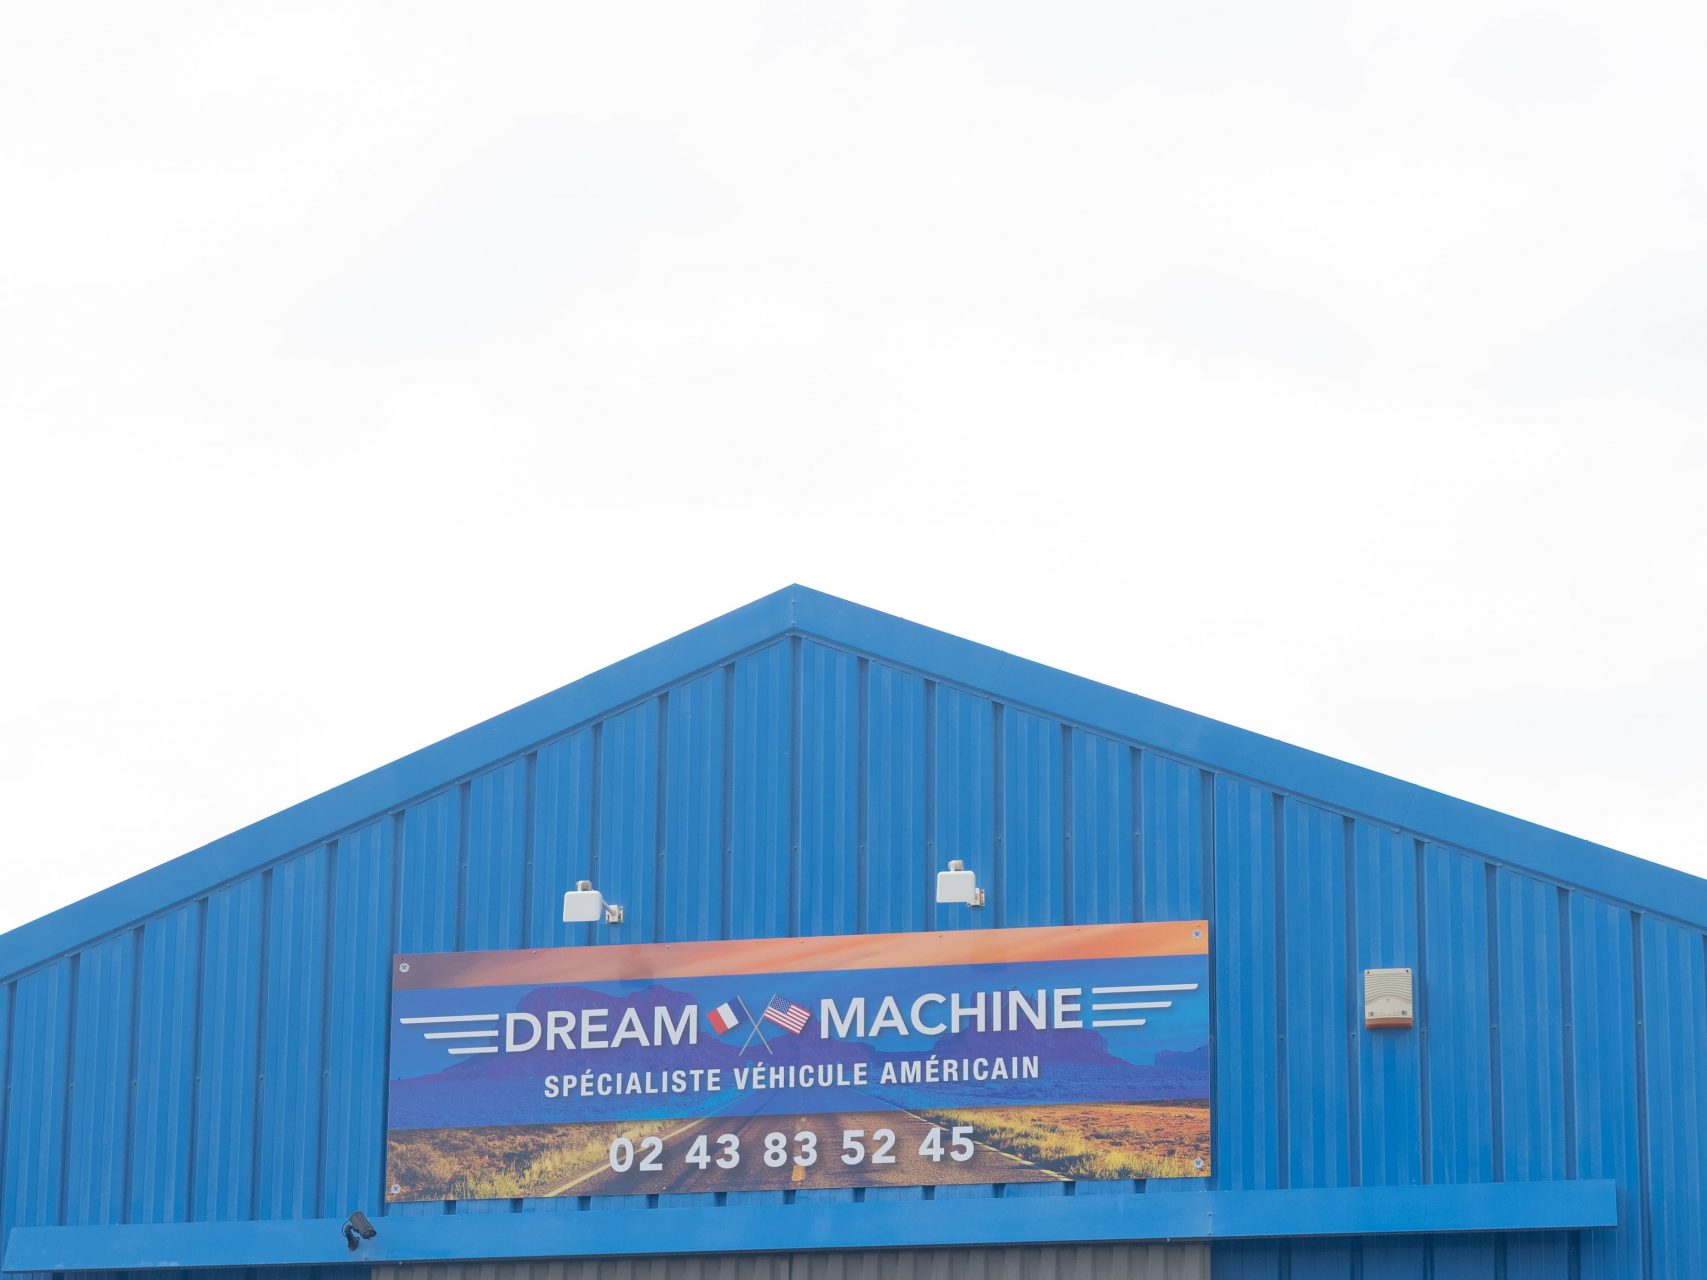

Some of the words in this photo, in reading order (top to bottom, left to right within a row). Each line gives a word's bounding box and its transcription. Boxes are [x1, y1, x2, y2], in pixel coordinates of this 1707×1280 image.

[505, 1004, 698, 1053] DREAM
[819, 987, 1084, 1039] MACHINE
[544, 1068, 721, 1098] SPÉCIALISTE
[734, 1061, 868, 1091] VÉHICULE
[880, 1054, 1040, 1085] AMÉRICAIN
[609, 1135, 663, 1173] 02
[685, 1133, 741, 1169] 43
[763, 1130, 818, 1167] 83
[840, 1128, 896, 1166] 52
[918, 1126, 975, 1163] 45
